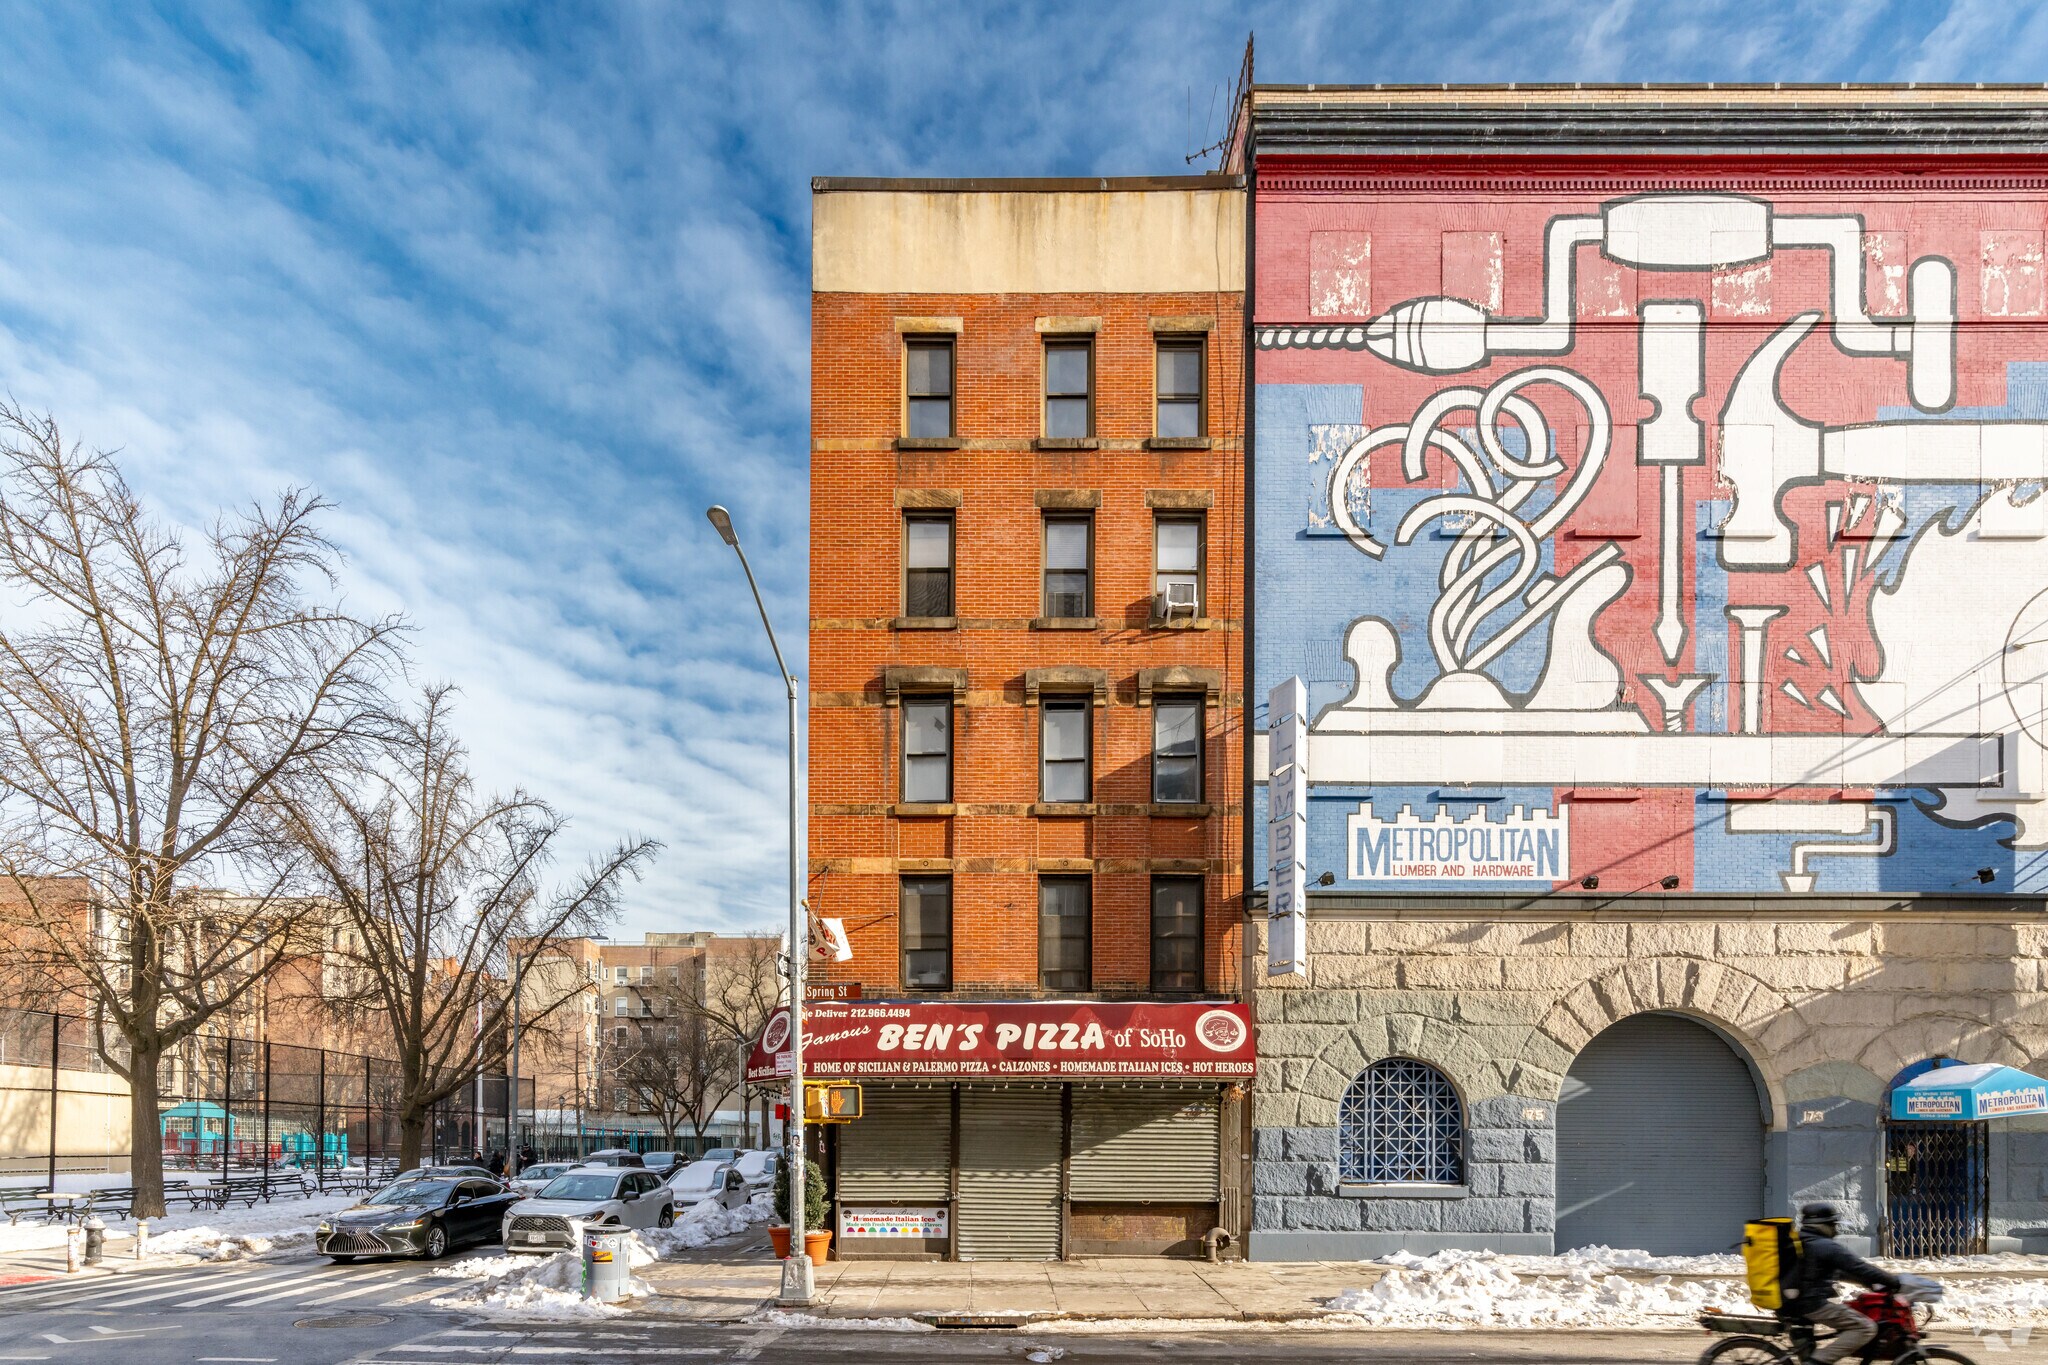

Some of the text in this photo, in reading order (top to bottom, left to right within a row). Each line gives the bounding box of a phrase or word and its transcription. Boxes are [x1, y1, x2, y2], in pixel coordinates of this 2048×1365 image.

[1357, 827, 1559, 877] METROPOLITAN
[1393, 865, 1534, 877] LUMBER AND HARDWARE
[807, 986, 847, 999] Spring St
[815, 1009, 848, 1018] Deliver
[850, 1008, 911, 1018] 212.966.4494
[876, 1023, 984, 1051] BEN'S
[995, 1022, 1105, 1051] PIZZA
[1114, 1029, 1134, 1048] of
[1140, 1028, 1186, 1048] SoHo
[748, 1065, 776, 1079] Best Sicilian
[813, 1062, 841, 1073] HOME
[843, 1062, 856, 1073] OF
[857, 1062, 900, 1073] SICILIAN
[902, 1061, 910, 1072] &
[912, 1062, 958, 1073] PALERMO
[960, 1061, 989, 1072] PIZZA
[999, 1061, 1050, 1072] CALZONES
[1060, 1061, 1117, 1072] HOMEMADE
[1118, 1062, 1159, 1072] ITALIAN
[1160, 1062, 1183, 1073] ICES
[1192, 1062, 1213, 1073] HOT
[1215, 1062, 1254, 1073] HEROES
[1908, 1100, 1960, 1113] METROPOLITAN
[1979, 1093, 2045, 1114] METROPOLITAN
